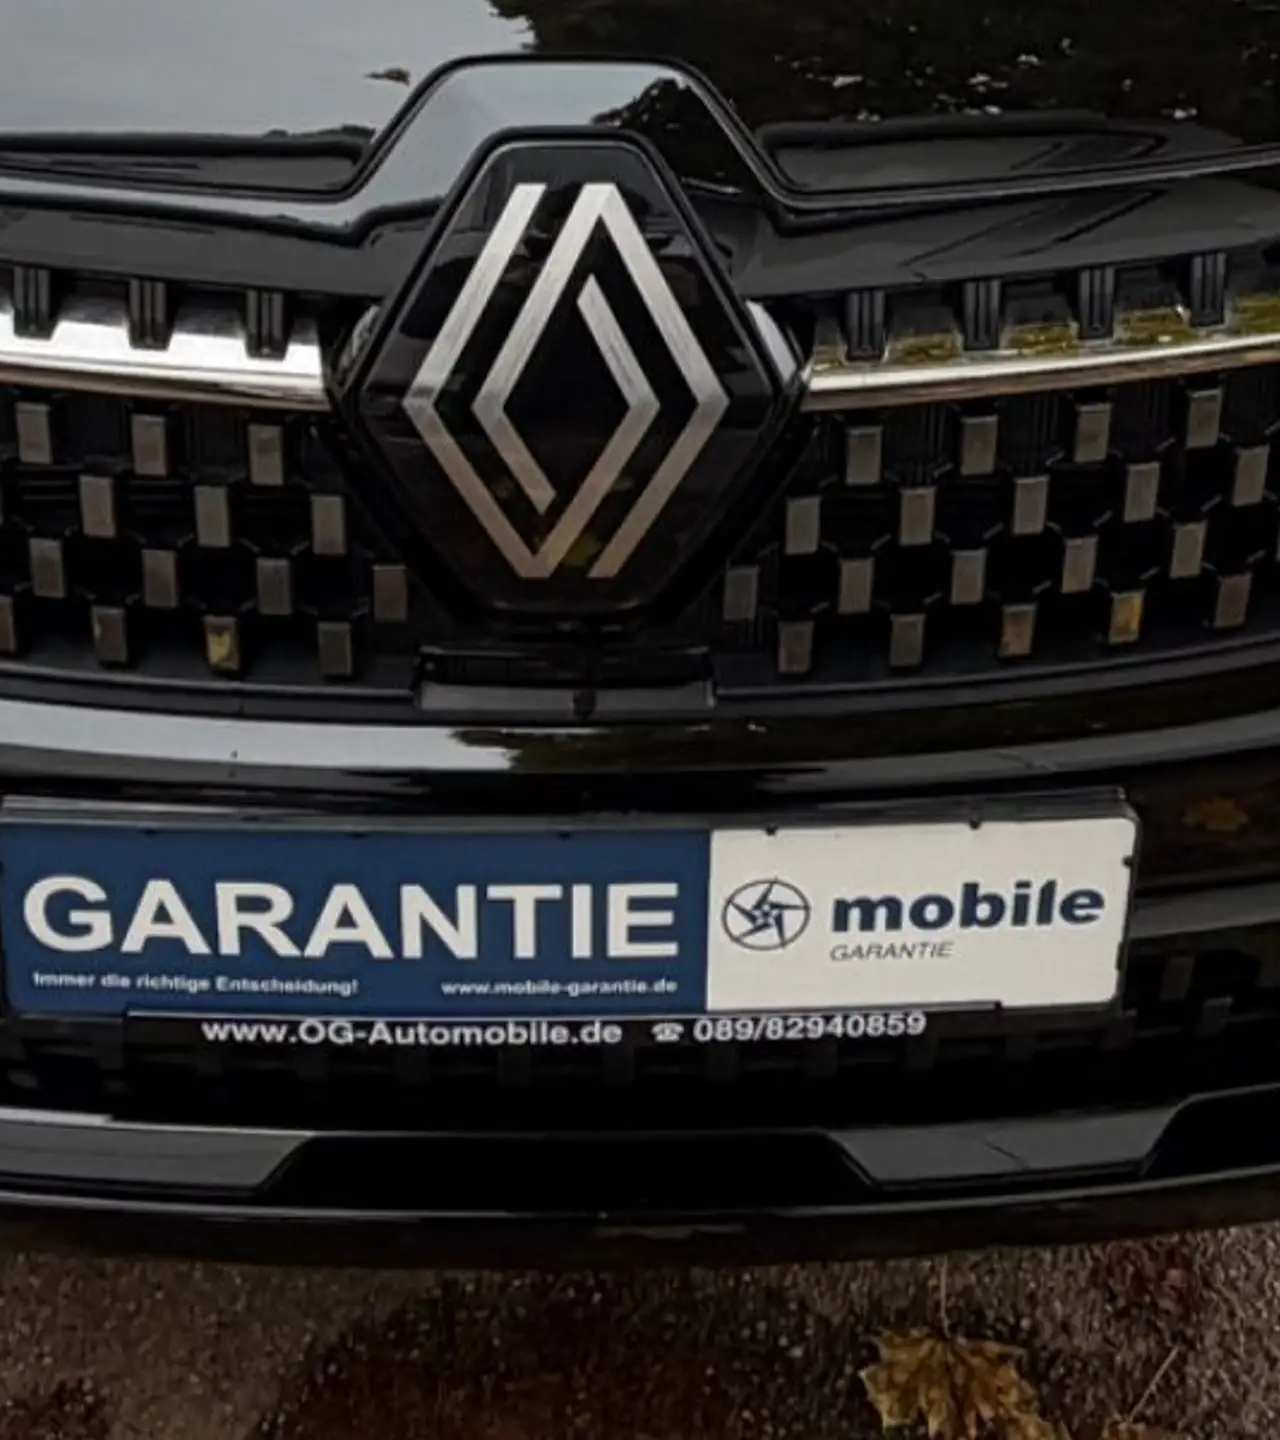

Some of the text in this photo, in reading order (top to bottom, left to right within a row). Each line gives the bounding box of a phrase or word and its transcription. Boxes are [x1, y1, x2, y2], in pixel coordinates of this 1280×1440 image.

[23, 875, 680, 959] GARANTIE
[832, 880, 1106, 933] mobile
[829, 942, 954, 962] GARANTIE
[32, 971, 360, 997] Immer die richtige Entscheidung!
[440, 978, 679, 998] www.mobile-garantie.de
[201, 1010, 927, 1046] www.OG-Automobile.de 089/82940859
